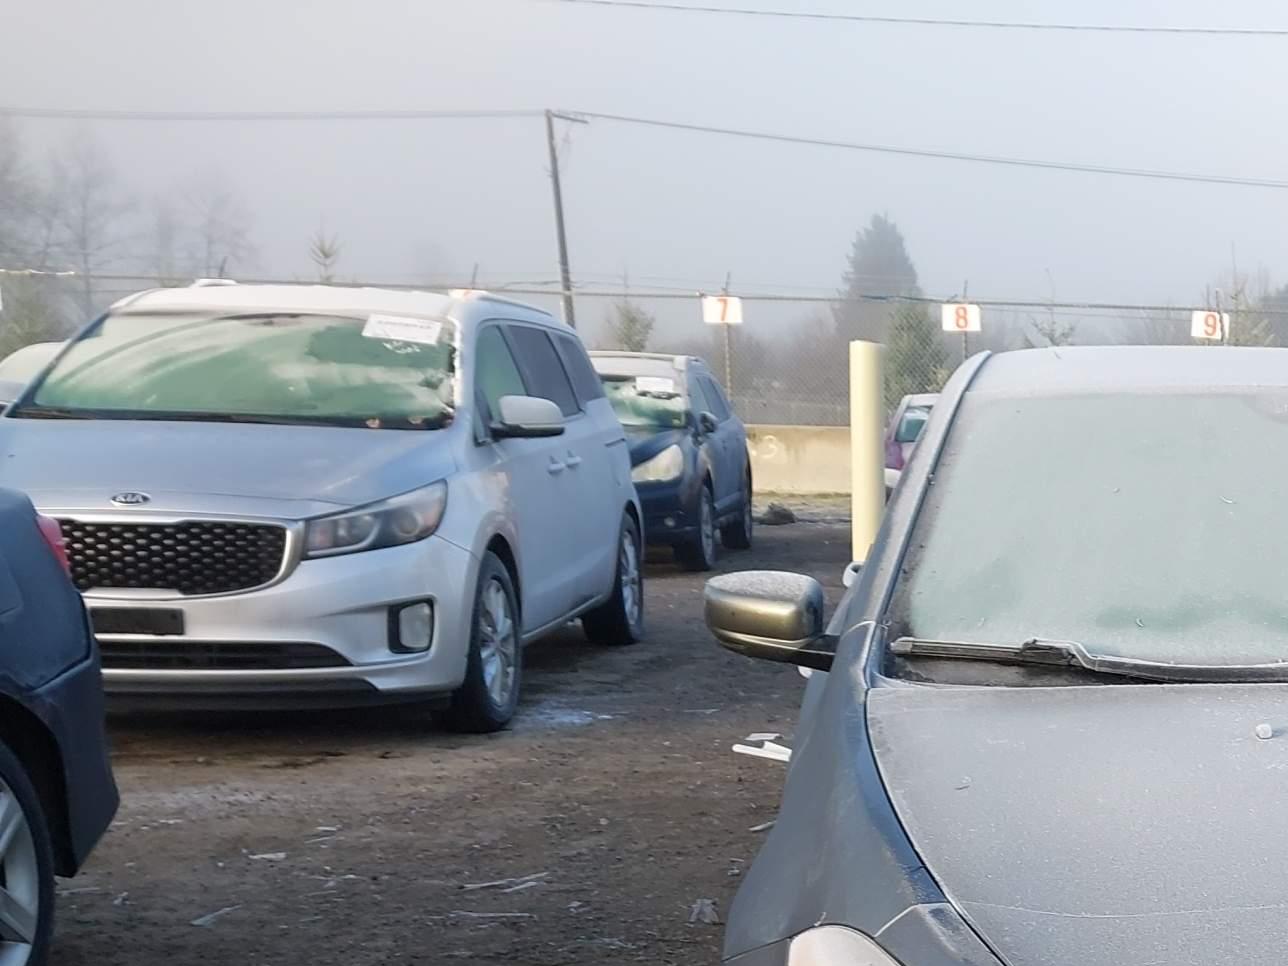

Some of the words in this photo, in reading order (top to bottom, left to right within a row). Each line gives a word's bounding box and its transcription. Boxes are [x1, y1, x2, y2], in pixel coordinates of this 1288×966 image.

[717, 298, 728, 321] 7
[955, 306, 968, 330] 8
[1203, 313, 1217, 336] 9
